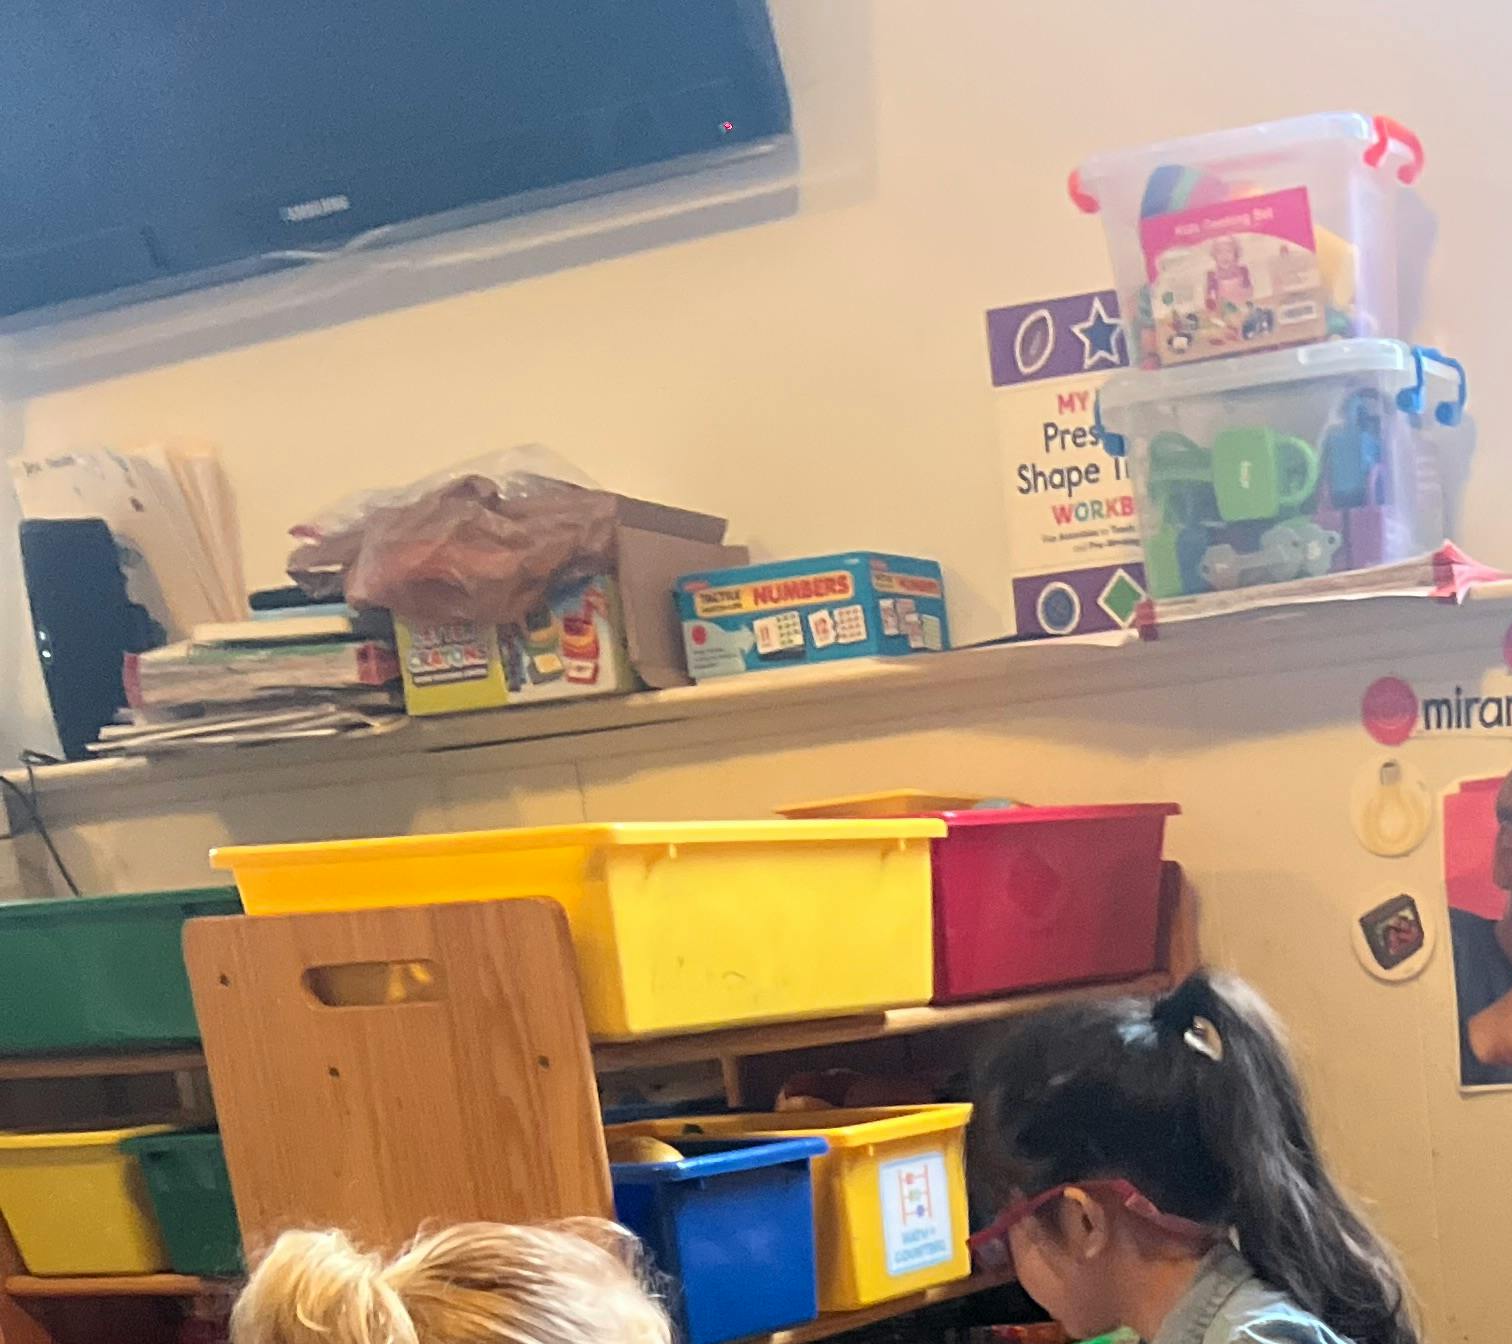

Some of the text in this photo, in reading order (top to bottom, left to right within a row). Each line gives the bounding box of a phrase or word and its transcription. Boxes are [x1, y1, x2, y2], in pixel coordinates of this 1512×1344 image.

[1057, 390, 1090, 416] MY
[1043, 421, 1100, 454] Pres
[1017, 462, 1100, 498] Shape
[1052, 495, 1134, 526] WORKB
[752, 573, 851, 607] NUMBERS
